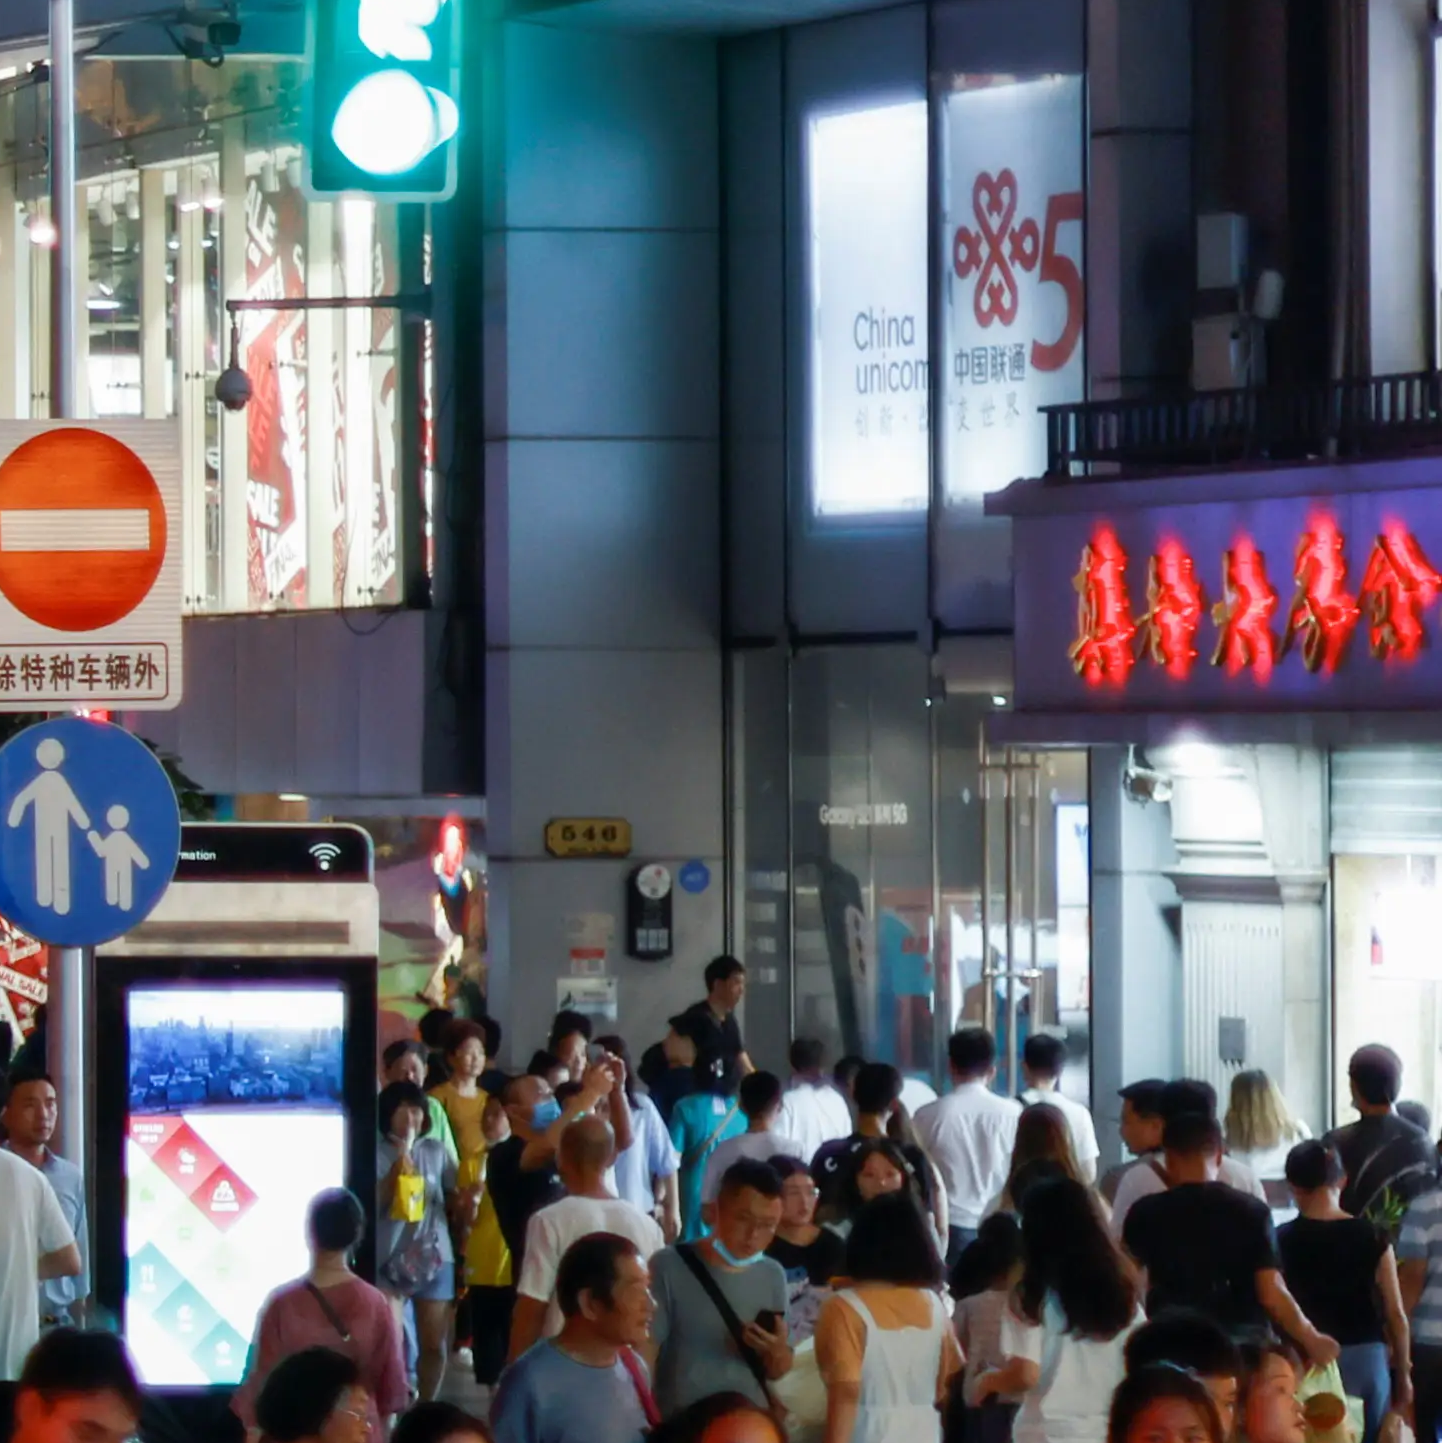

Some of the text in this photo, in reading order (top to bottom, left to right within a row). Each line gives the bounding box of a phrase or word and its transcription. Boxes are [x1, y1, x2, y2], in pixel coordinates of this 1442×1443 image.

[854, 305, 915, 352] China
[954, 342, 1027, 387] 中国联通
[561, 824, 617, 842] 546
